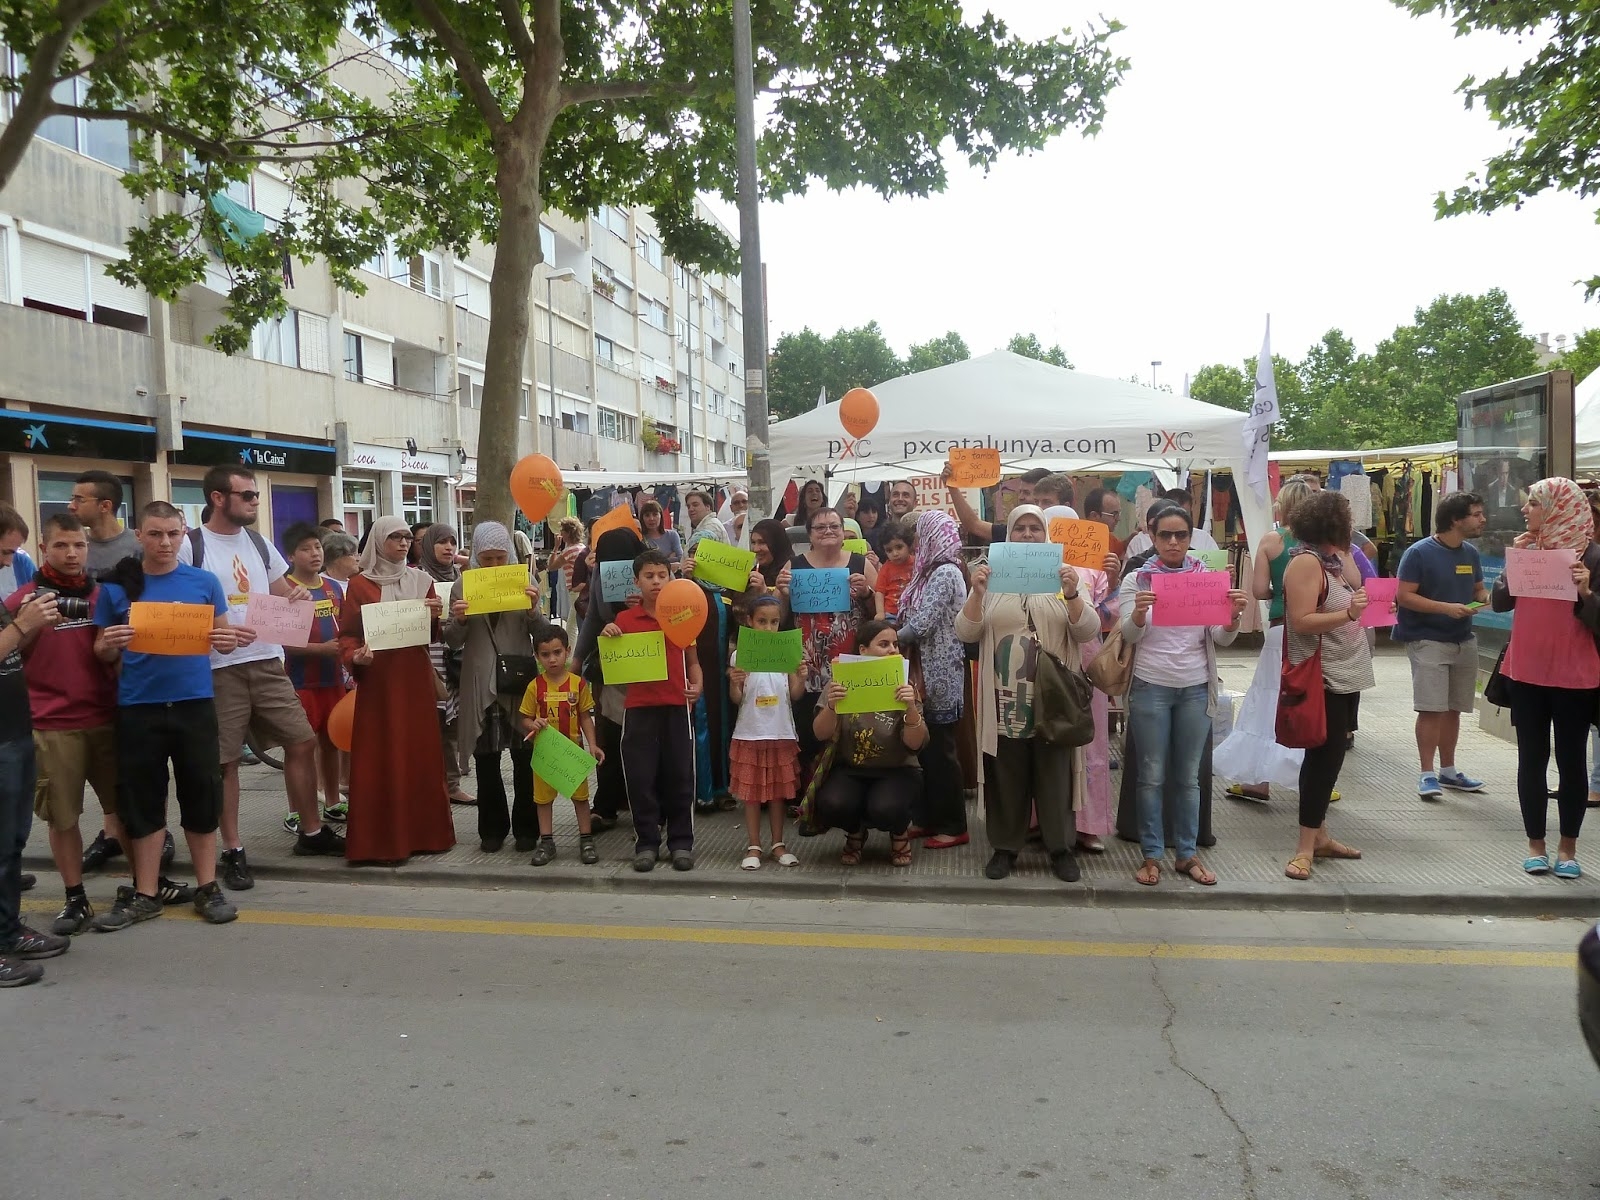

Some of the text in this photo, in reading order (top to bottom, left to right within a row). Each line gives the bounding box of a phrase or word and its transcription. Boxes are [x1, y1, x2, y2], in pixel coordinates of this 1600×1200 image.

[903, 434, 1116, 459] pxcatalunya.com
[1015, 566, 1058, 587] Igualada
[273, 616, 308, 634] Igualada
[391, 621, 429, 641] Igualada
